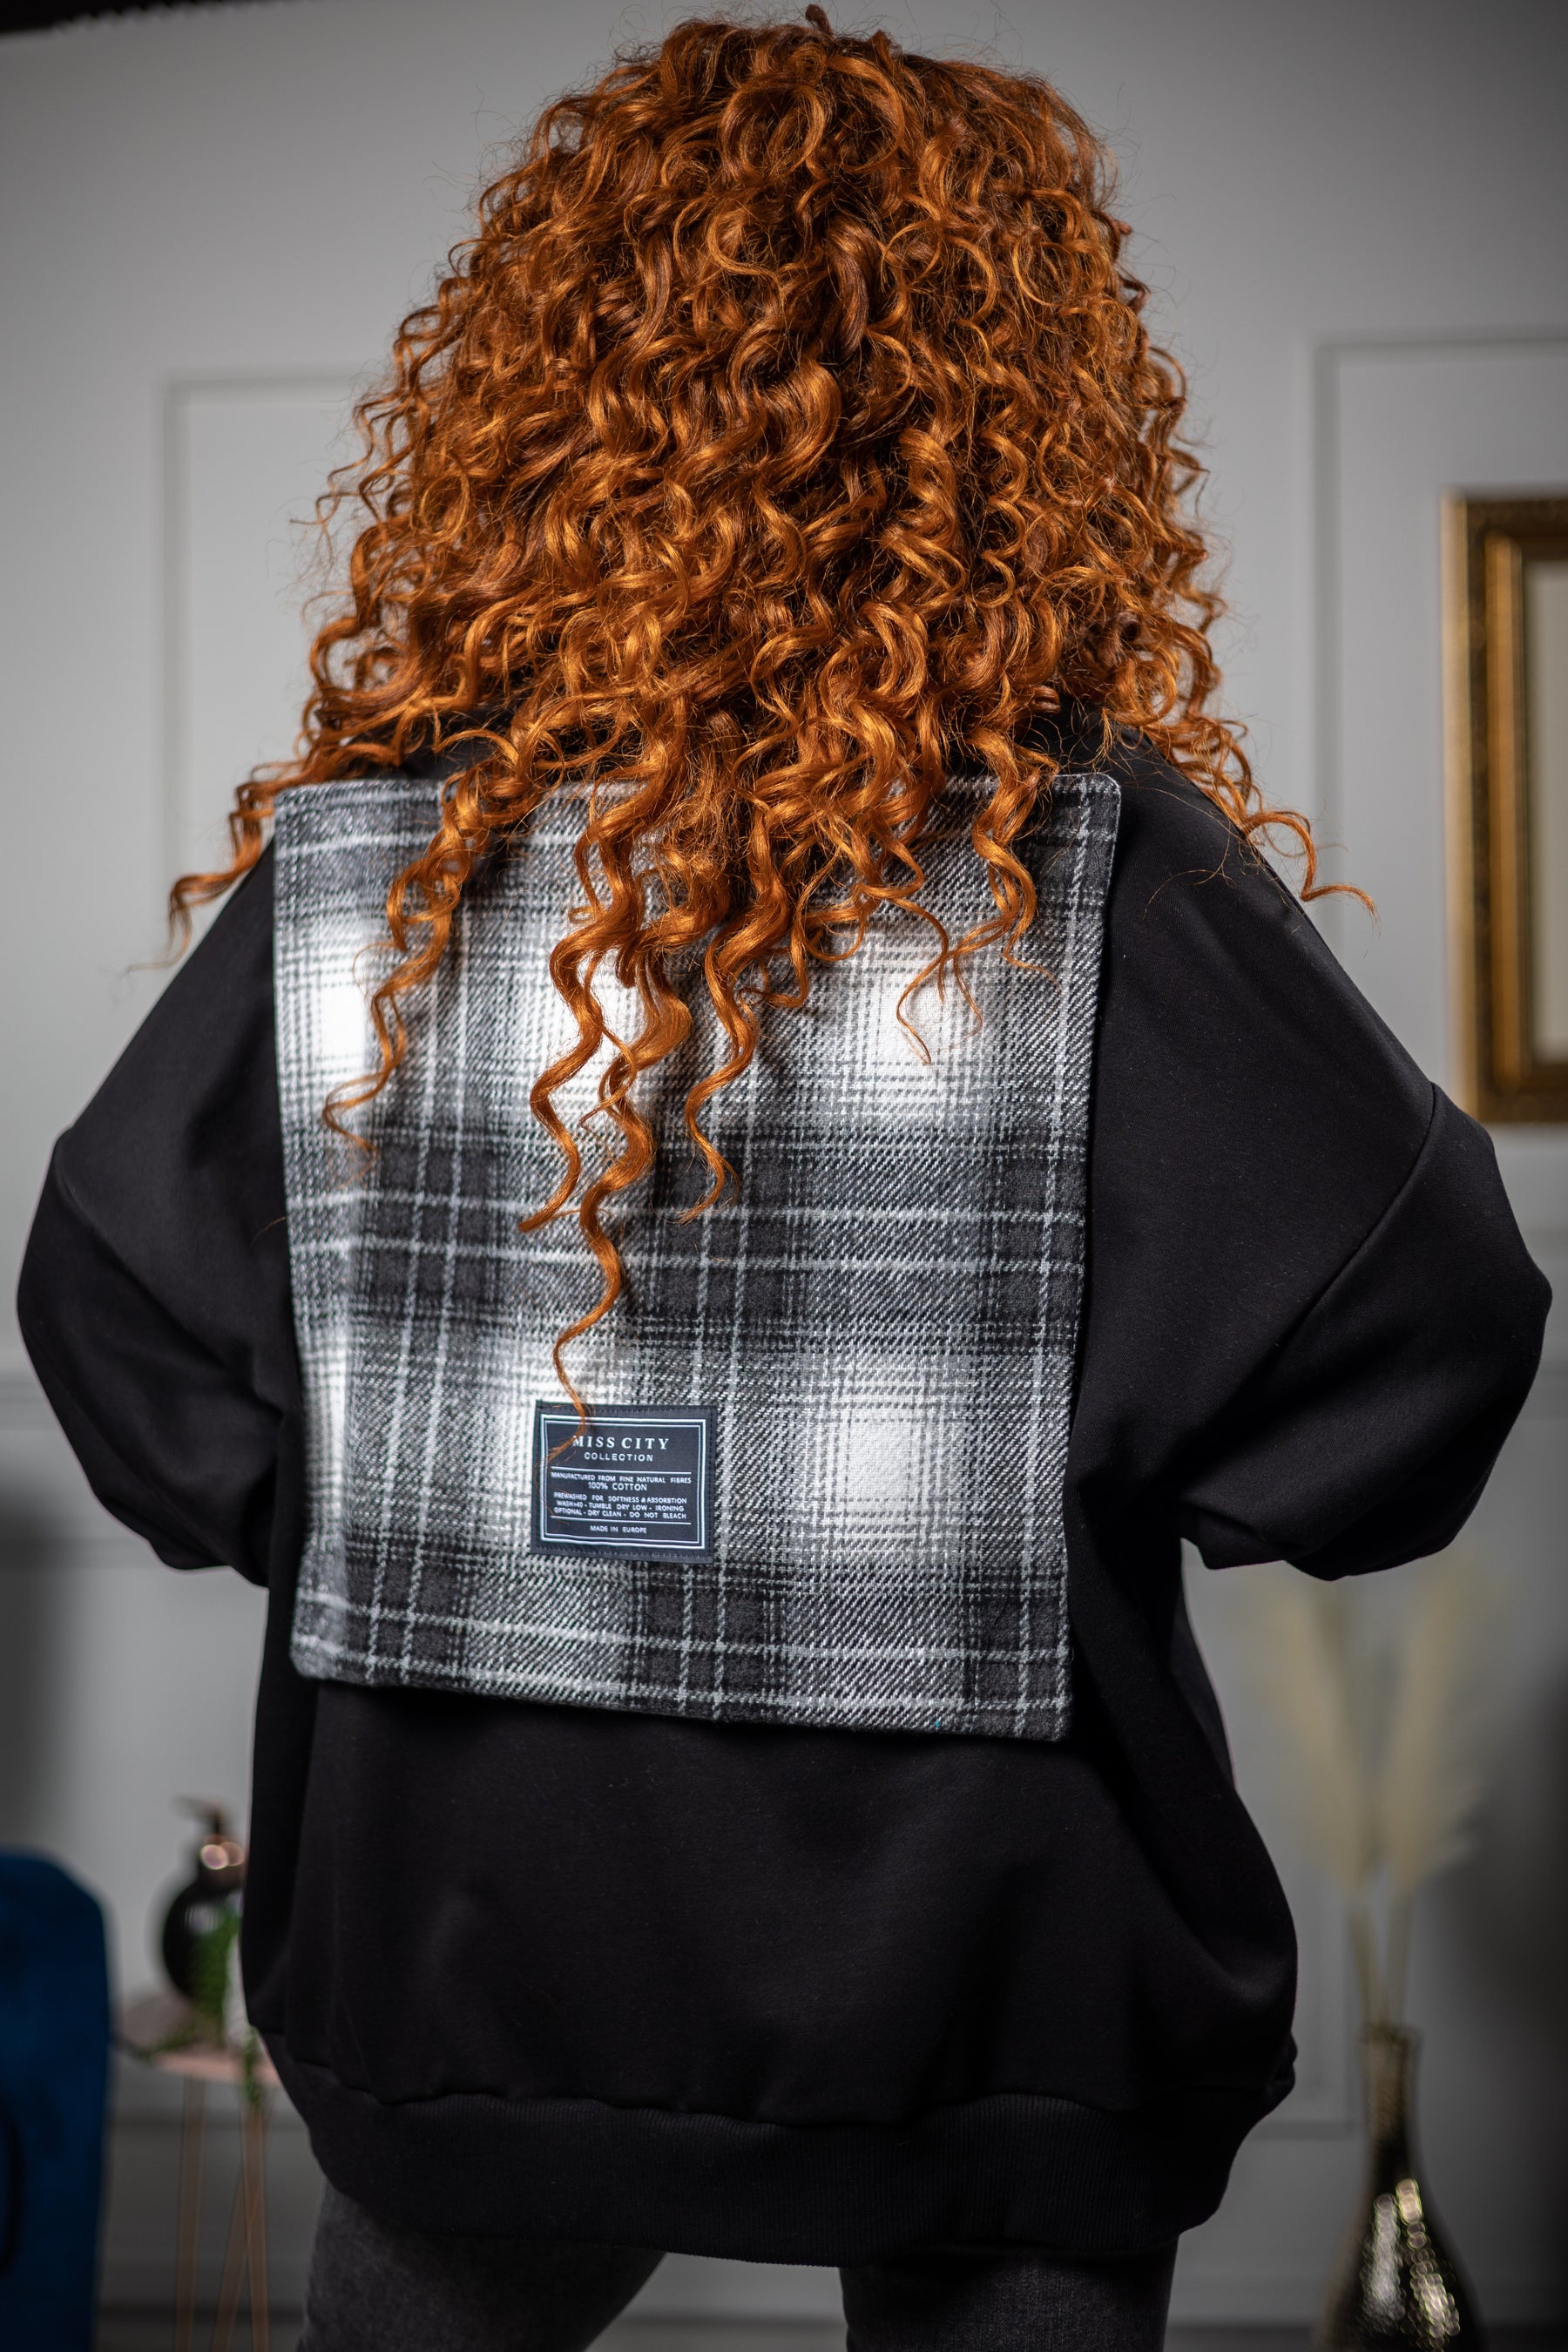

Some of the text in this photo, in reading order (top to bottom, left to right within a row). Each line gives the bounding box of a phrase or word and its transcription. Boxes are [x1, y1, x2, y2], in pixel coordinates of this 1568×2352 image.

[571, 1436, 669, 1450] MISS CITY
[584, 1452, 653, 1462] COLLECTION
[551, 1471, 596, 1480] MANUFACTURED
[612, 1483, 648, 1491] COTTON
[553, 1492, 587, 1501] PREWASHED
[553, 1507, 583, 1516] OPTIONAL
